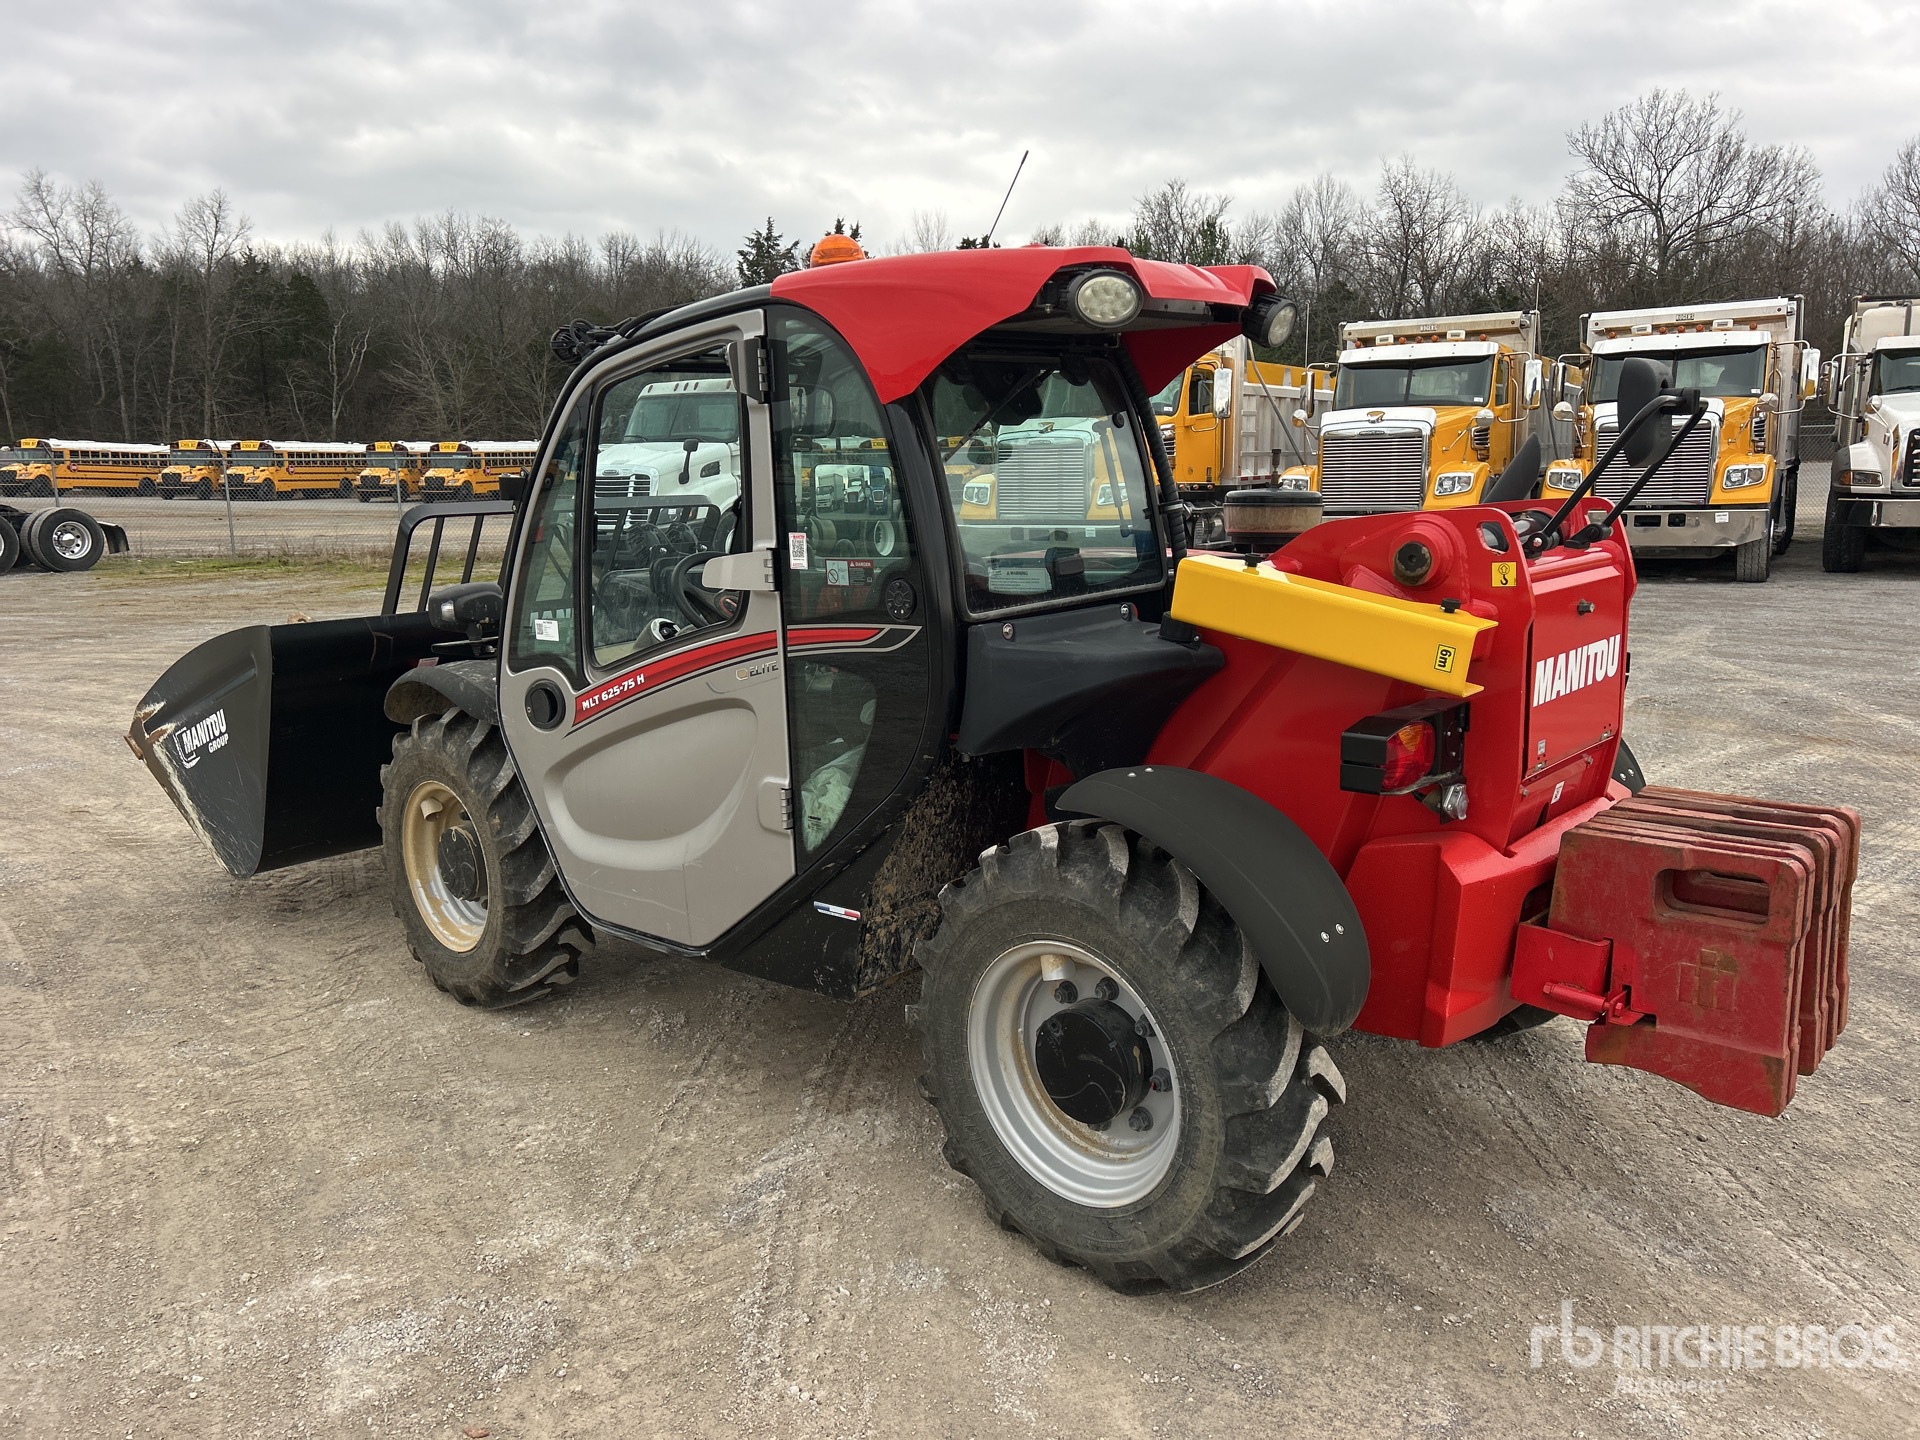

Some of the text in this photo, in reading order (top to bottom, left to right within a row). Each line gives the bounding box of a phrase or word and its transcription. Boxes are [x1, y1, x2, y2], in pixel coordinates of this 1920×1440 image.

[750, 660, 778, 677] ELITE
[1438, 649, 1452, 668] 6m
[1533, 634, 1621, 708] MANITOU
[582, 673, 645, 710] MLT 625-75 H
[182, 709, 227, 754] MANITOU
[208, 733, 229, 753] GROUP
